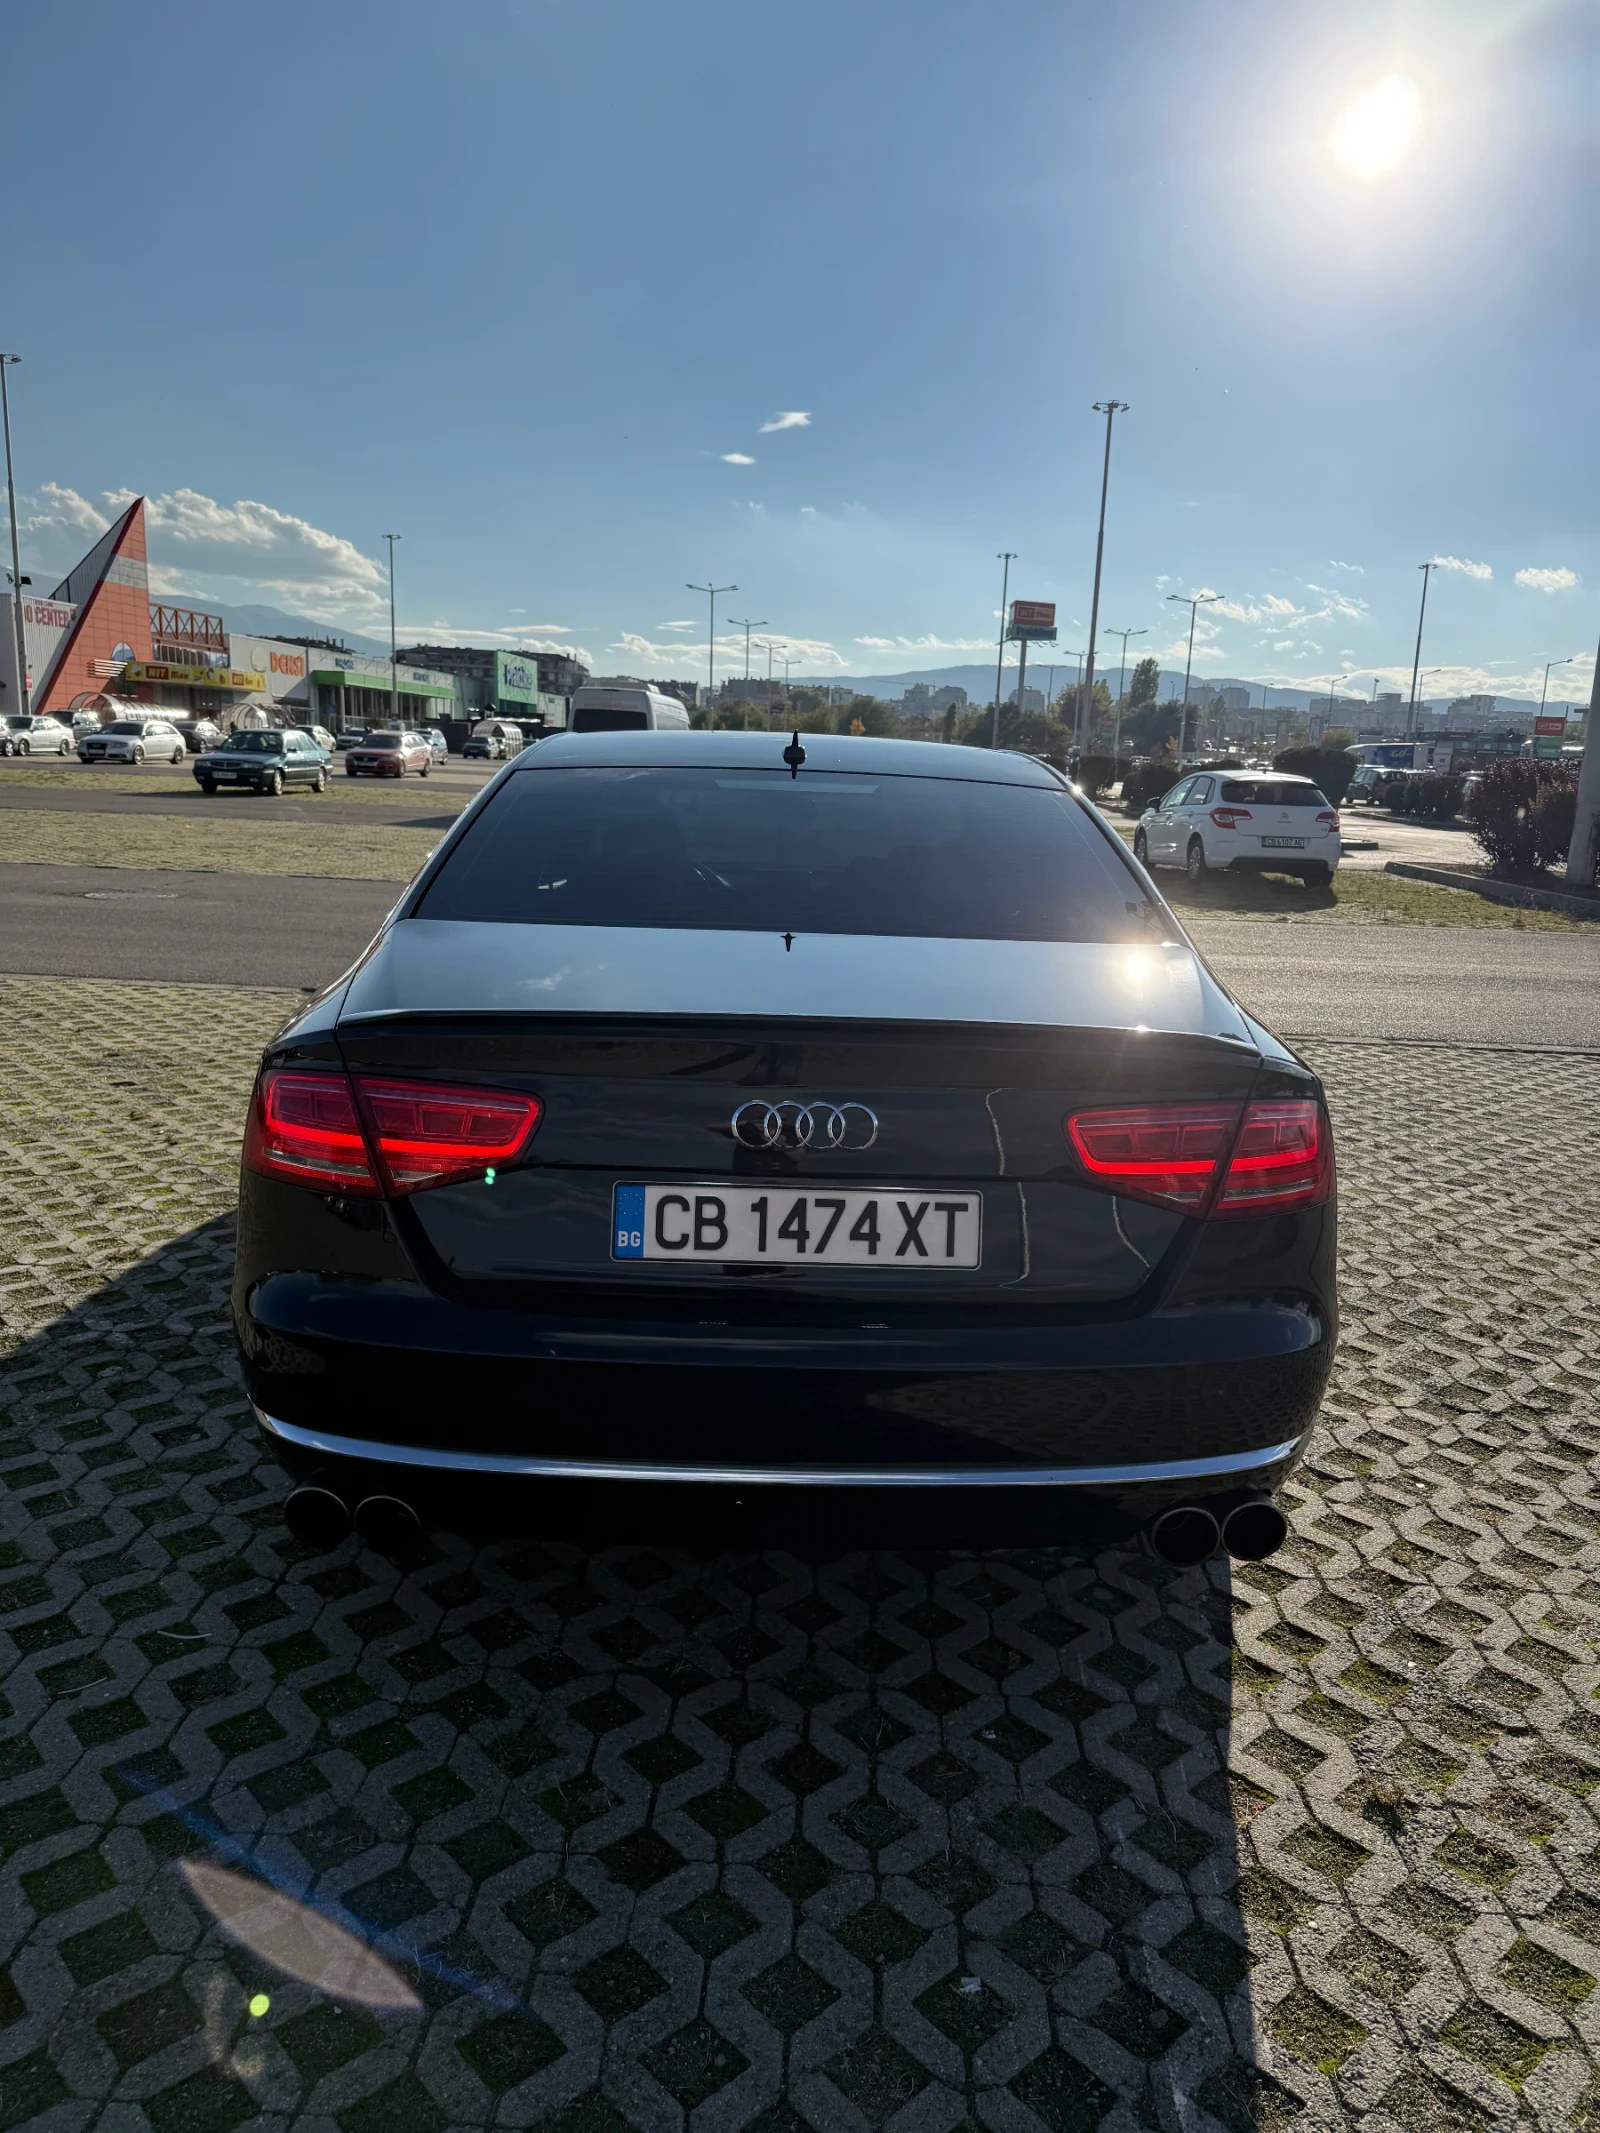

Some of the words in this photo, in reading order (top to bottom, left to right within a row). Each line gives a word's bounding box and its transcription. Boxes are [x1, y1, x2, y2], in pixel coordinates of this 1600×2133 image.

[148, 667, 167, 678] HIT
[655, 1194, 729, 1251] CB
[751, 1196, 881, 1255] 1474
[895, 1201, 969, 1257] XT
[617, 1230, 642, 1248] BG
